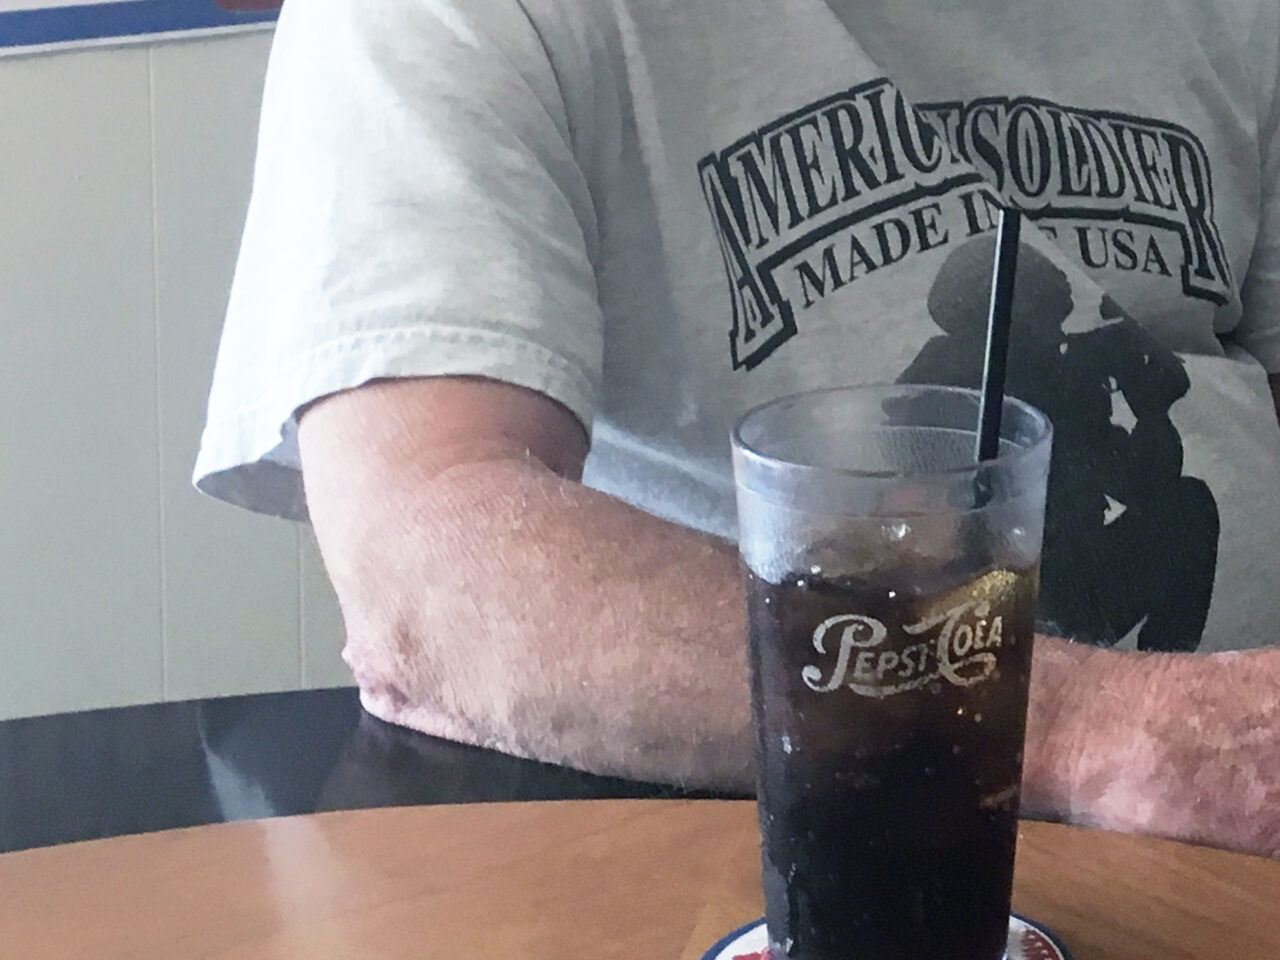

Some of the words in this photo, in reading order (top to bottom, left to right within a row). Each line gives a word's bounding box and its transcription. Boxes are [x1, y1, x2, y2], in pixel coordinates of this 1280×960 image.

[699, 85, 958, 346] AMERIC
[964, 99, 1234, 289] SOLDIER
[793, 203, 949, 308] MADE
[1073, 225, 1173, 277] USA
